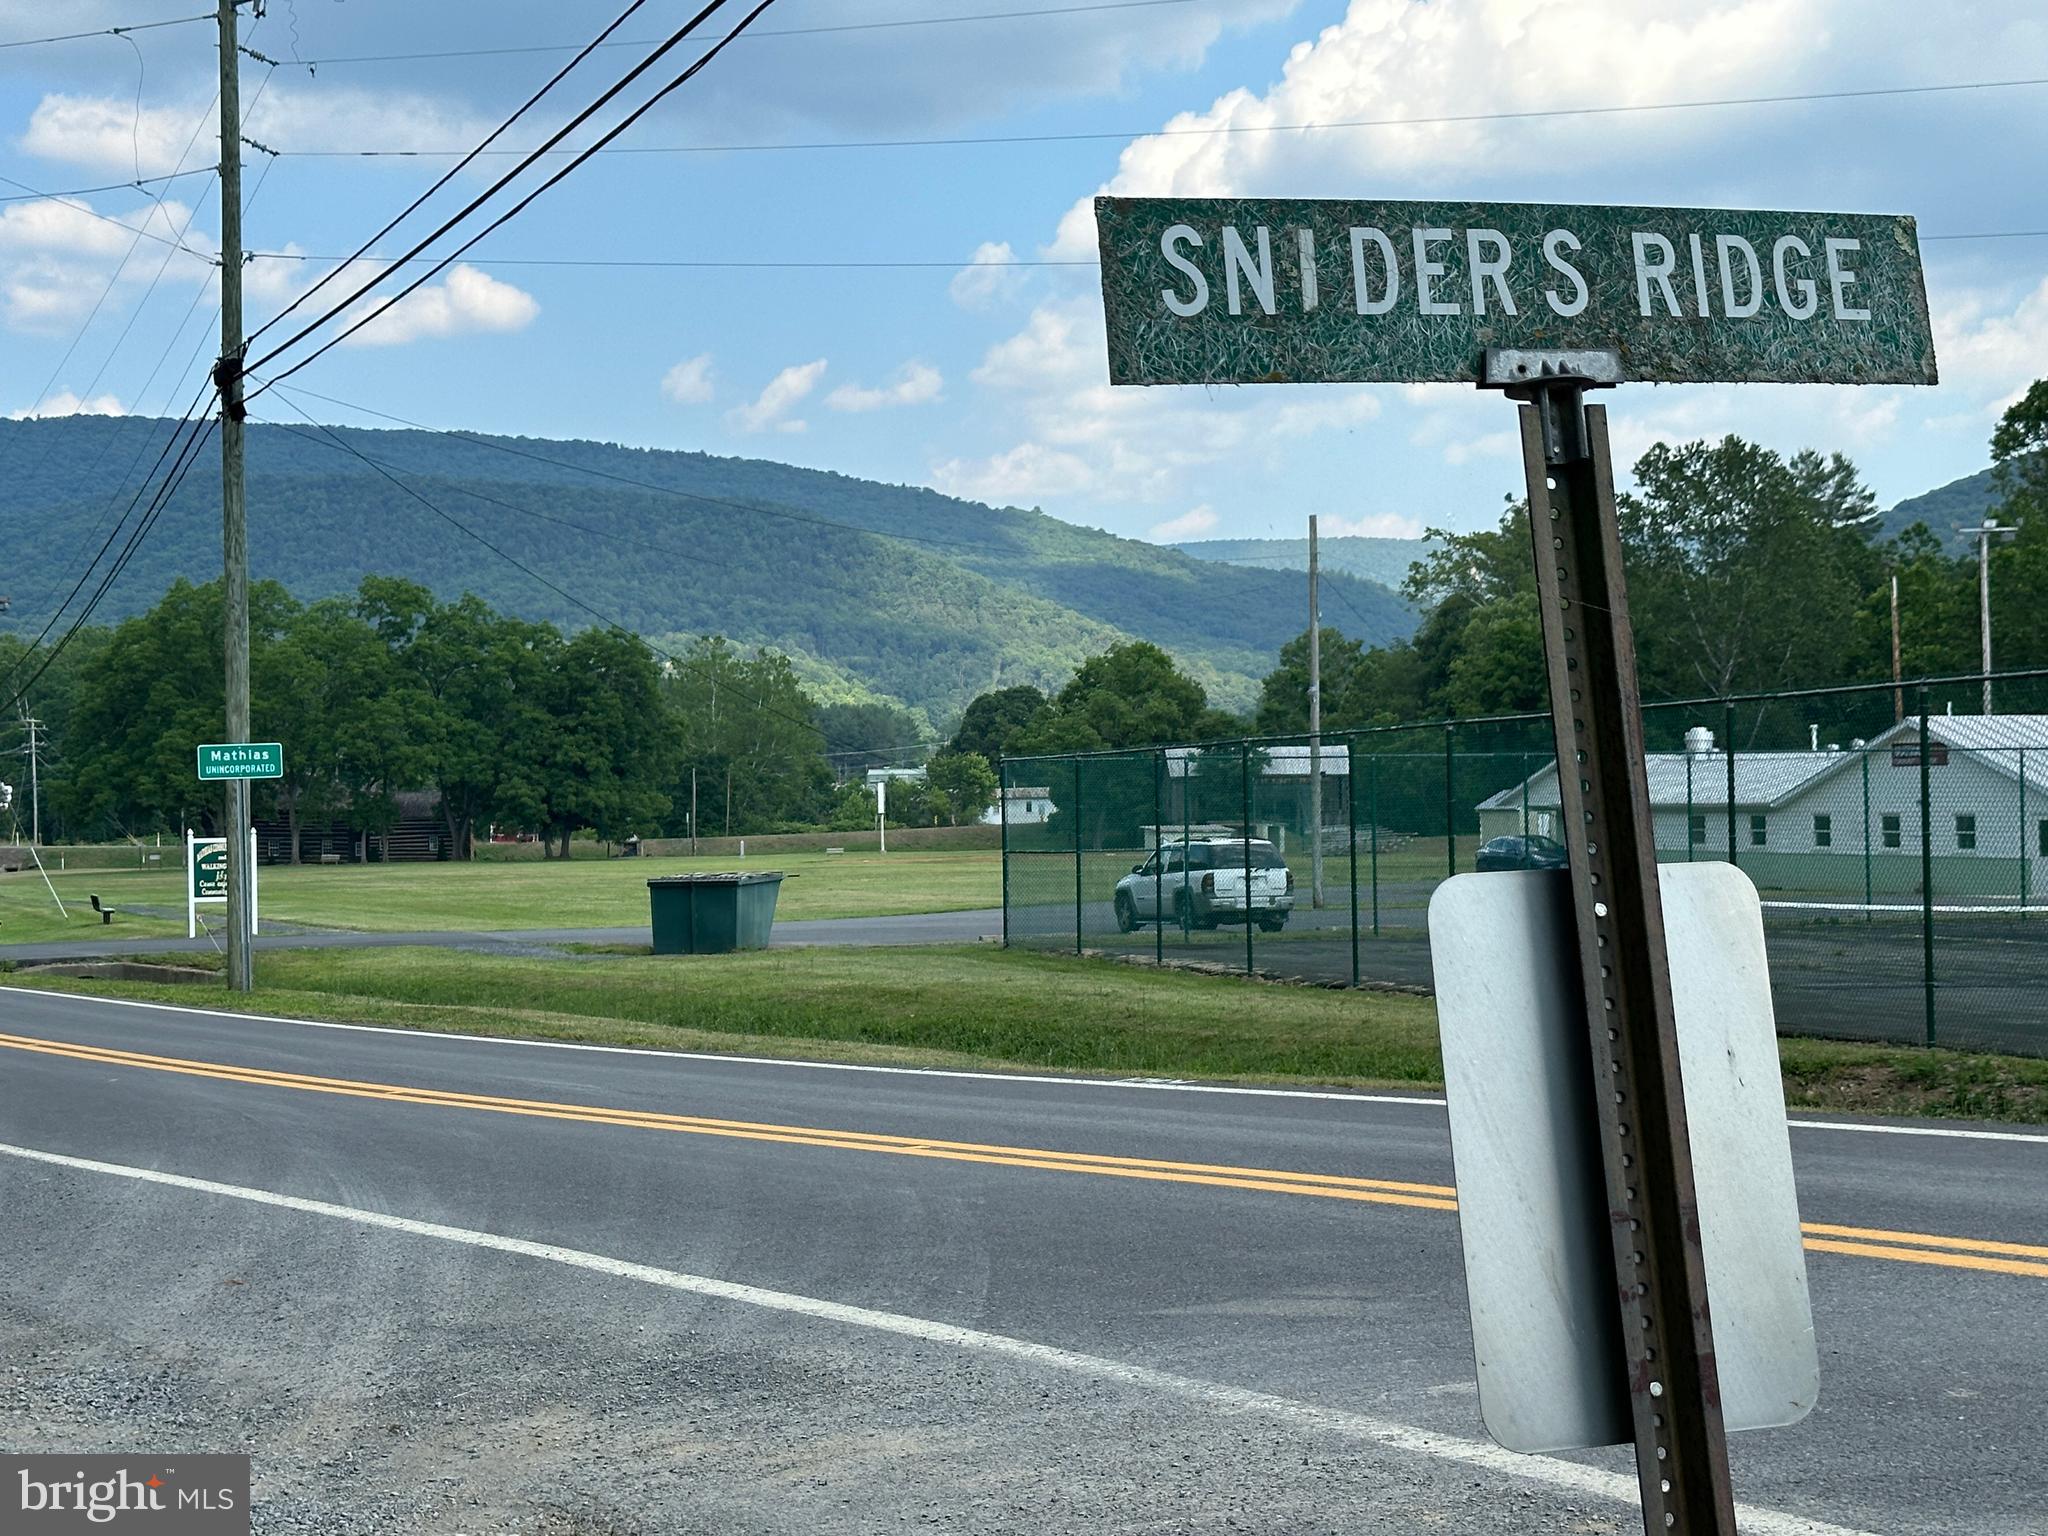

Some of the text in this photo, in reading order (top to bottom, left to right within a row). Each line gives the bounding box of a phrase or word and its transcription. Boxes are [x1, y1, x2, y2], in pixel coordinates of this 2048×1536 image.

[1160, 224, 1871, 320] SNIDERS RIDGE
[211, 749, 269, 762] Mathias
[206, 763, 276, 775] UNINCORPORATED
